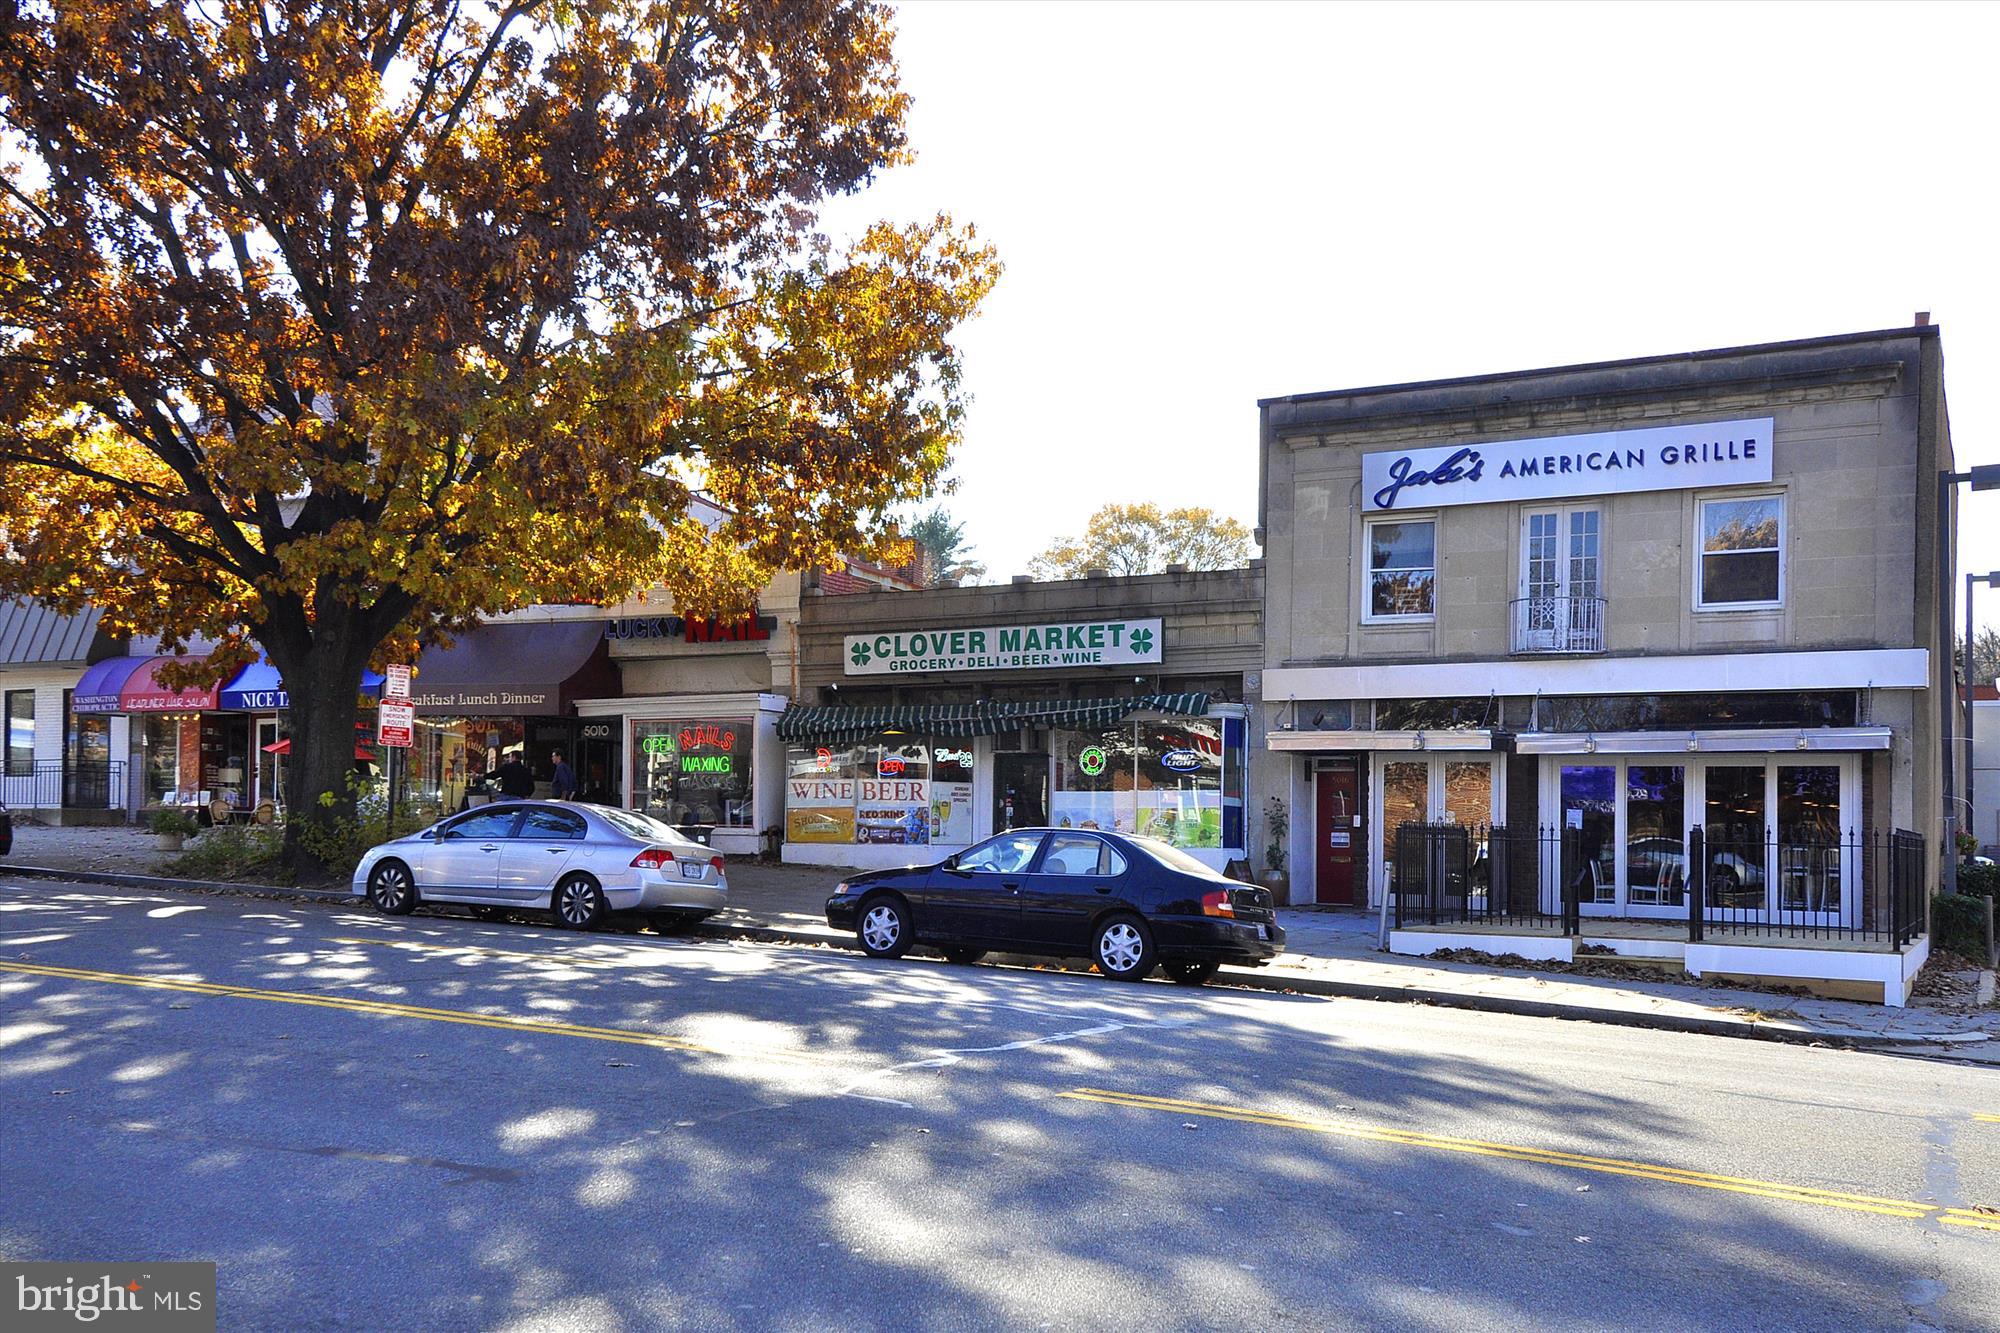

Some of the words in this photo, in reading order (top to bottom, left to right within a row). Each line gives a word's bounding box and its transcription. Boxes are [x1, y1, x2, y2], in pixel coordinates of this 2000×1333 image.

[1373, 448, 1483, 508] Jake's
[1500, 448, 1645, 478] AMERICAN
[1660, 439, 1757, 465] GRILLE
[604, 617, 678, 640] LUCKY
[873, 631, 986, 658] CLOVER
[1000, 624, 1125, 653] MARKET
[889, 657, 955, 671] GROCERY
[967, 656, 1000, 668] DELI
[1012, 654, 1050, 666] BEER
[1062, 652, 1101, 664] WINE
[72, 703, 121, 711] CHIROPRACTIC
[74, 696, 118, 704] WASHINGTON
[185, 695, 211, 708] SALON
[242, 692, 275, 708] NICE
[411, 694, 455, 706] eakfast
[458, 692, 497, 706] Lunch
[501, 692, 546, 705] Dinner
[583, 725, 610, 737] 5010
[677, 725, 736, 751] NAILS
[642, 737, 675, 753] OPEN
[681, 756, 731, 773] WAXING
[878, 760, 906, 774] OPEN
[791, 782, 853, 800] WINE
[862, 781, 925, 801] BEER
[859, 809, 906, 819] REDSKINS
